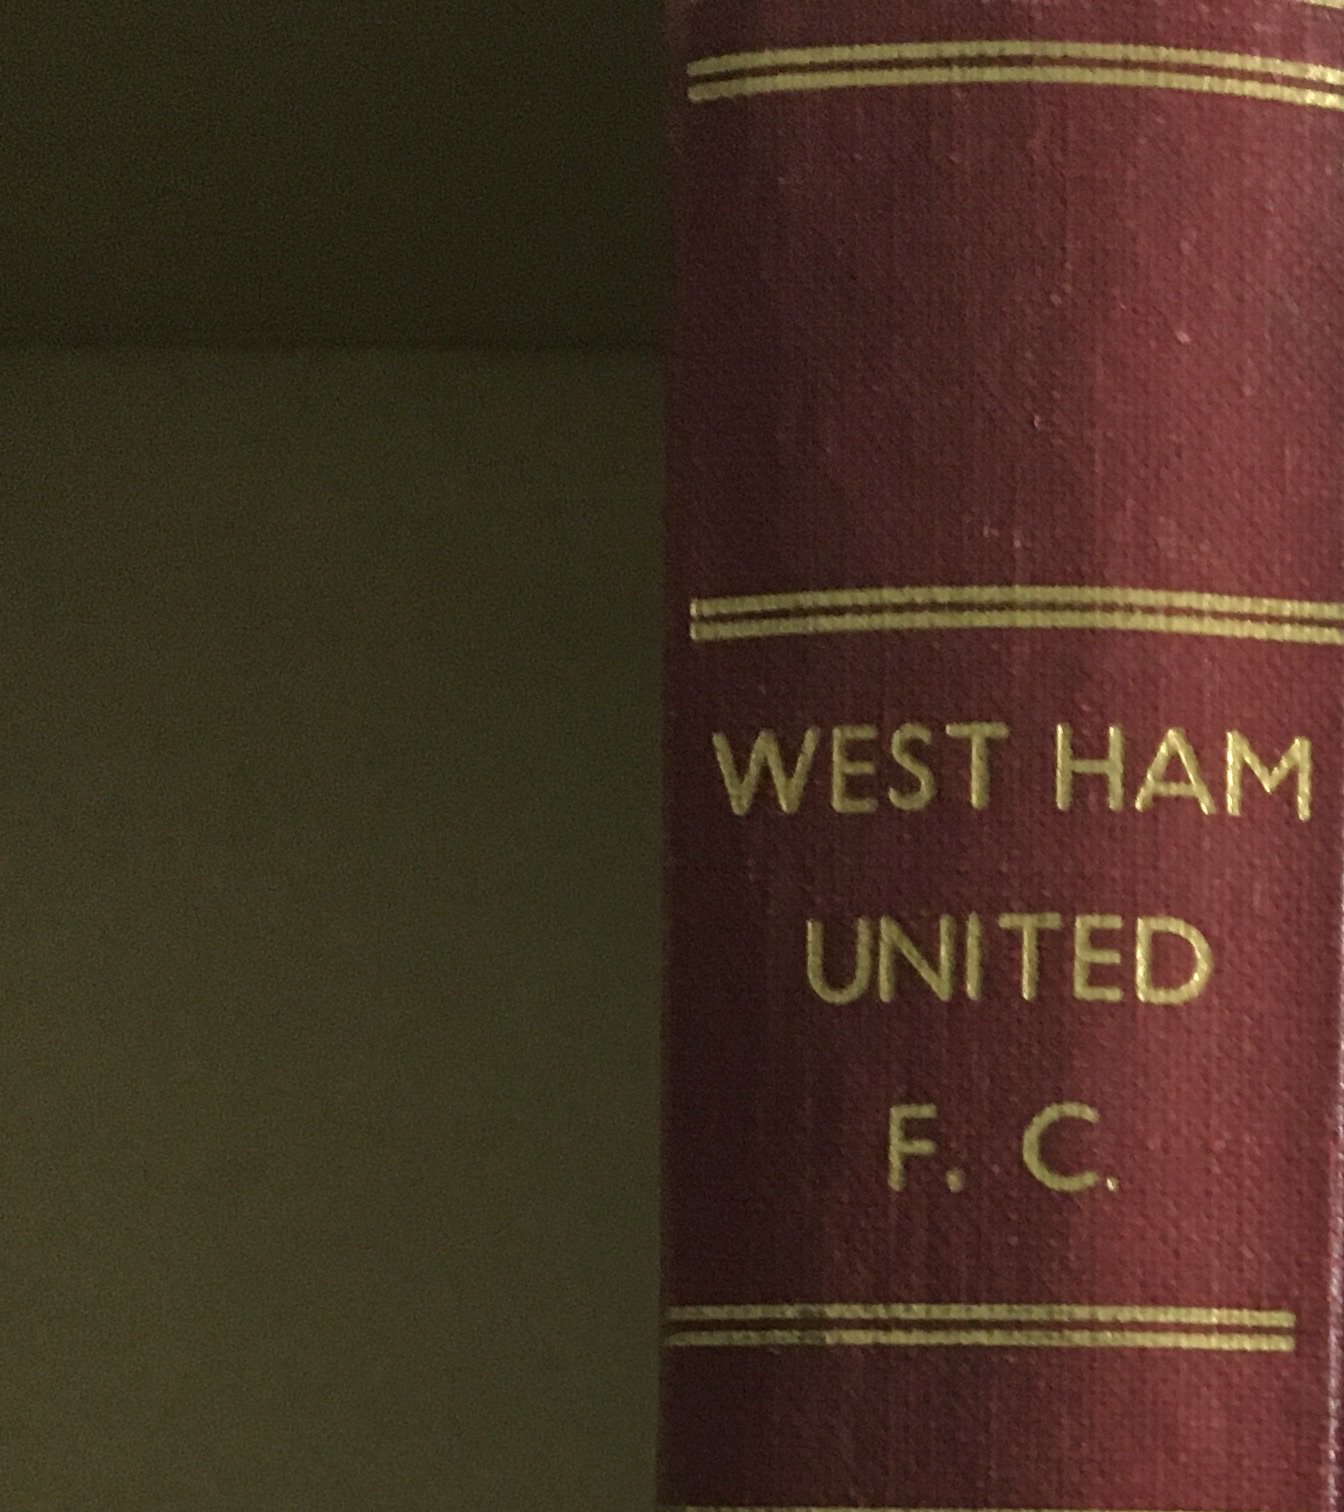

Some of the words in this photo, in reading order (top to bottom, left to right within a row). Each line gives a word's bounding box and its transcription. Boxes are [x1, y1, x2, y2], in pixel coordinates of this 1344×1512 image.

[713, 721, 1009, 814] WEST
[1055, 724, 1312, 820] HAM
[807, 912, 1213, 1005] UNITED
[887, 1103, 962, 1190] F.
[1021, 1101, 1118, 1193] C.
